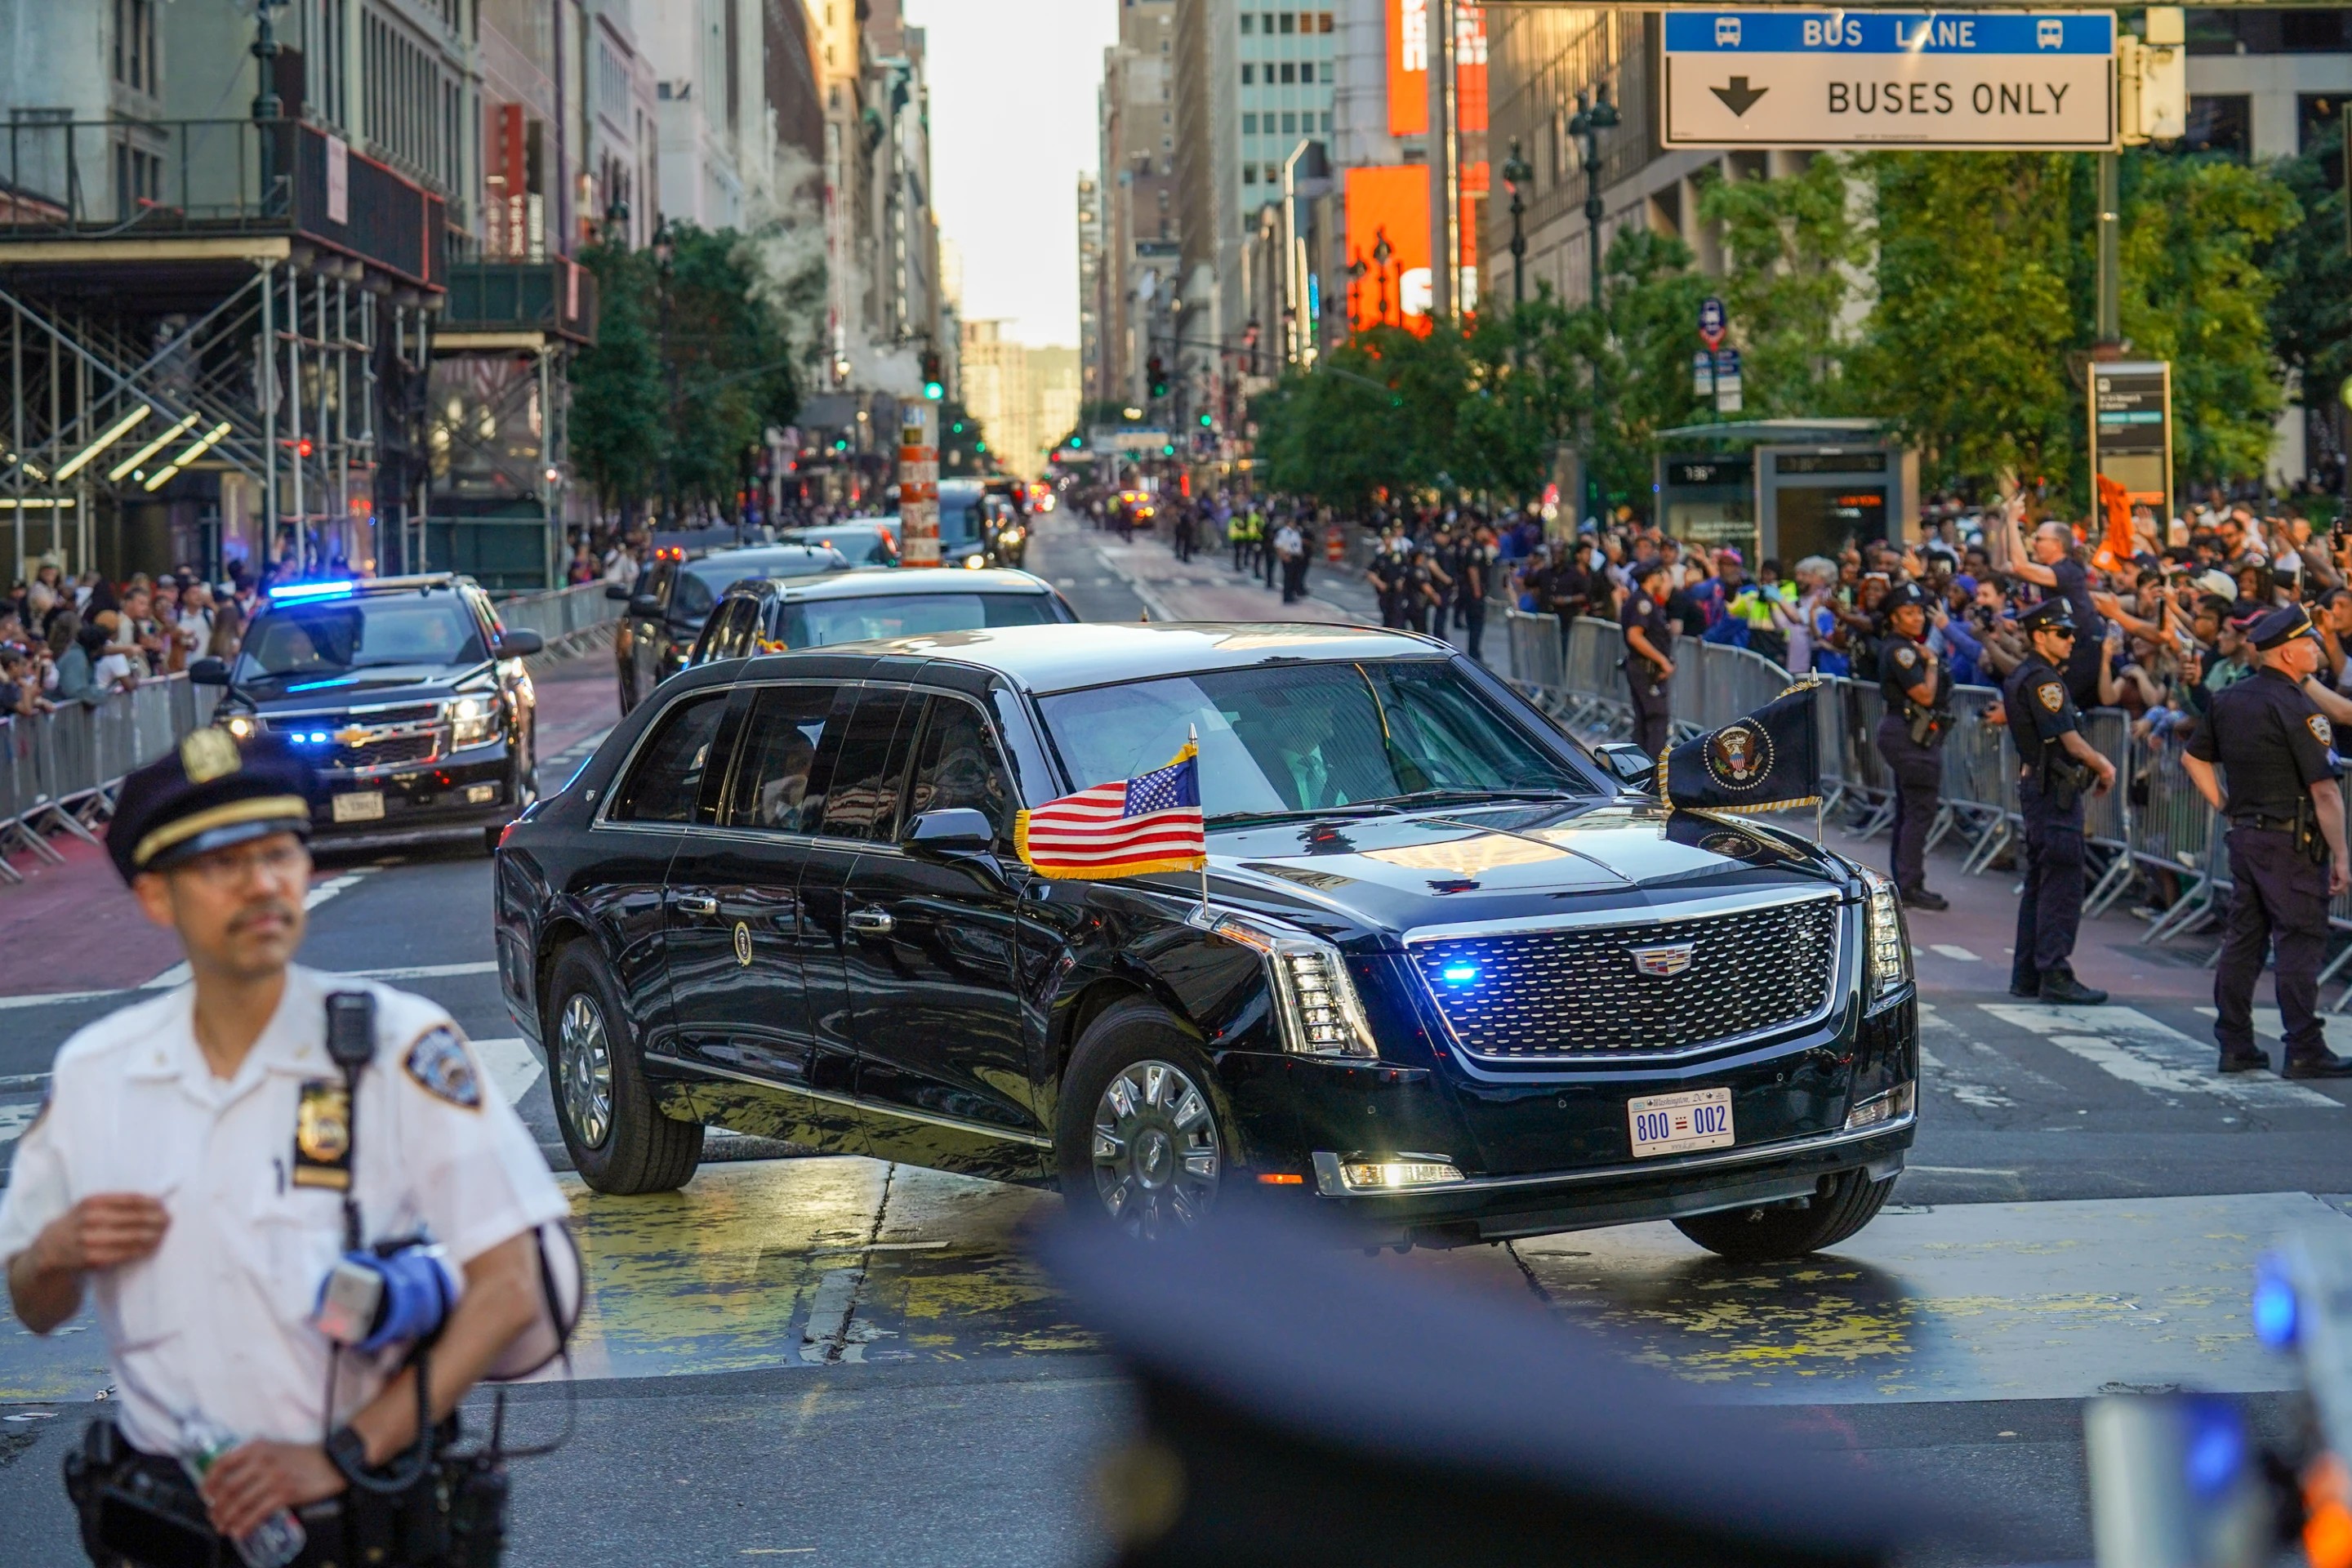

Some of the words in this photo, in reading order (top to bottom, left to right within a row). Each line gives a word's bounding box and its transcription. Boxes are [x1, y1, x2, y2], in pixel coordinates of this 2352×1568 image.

[1803, 20, 1863, 47] BUS
[1895, 20, 1976, 47] LANE
[1829, 82, 1953, 114] BUSES
[1972, 82, 2069, 114] ONLY
[1637, 1112, 1669, 1141] 800
[1694, 1105, 1727, 1134] 002
